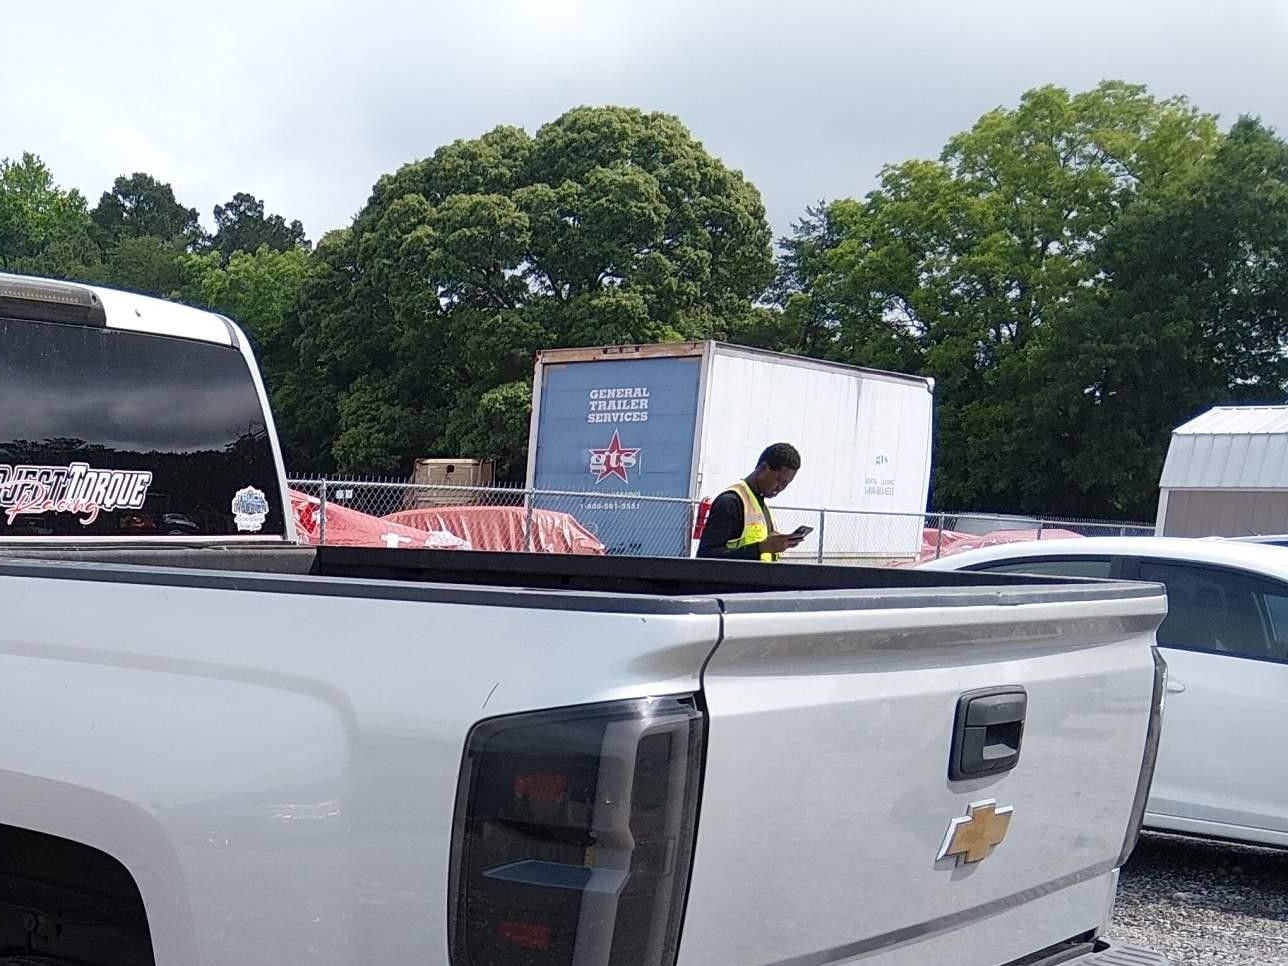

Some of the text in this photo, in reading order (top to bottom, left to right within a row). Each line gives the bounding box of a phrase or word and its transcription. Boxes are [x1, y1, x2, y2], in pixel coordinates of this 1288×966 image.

[589, 387, 650, 399] GENERAL
[589, 399, 649, 411] TRAILER
[587, 411, 649, 423] SERVICES
[589, 449, 637, 475] gts
[66, 463, 152, 511] TORQUE
